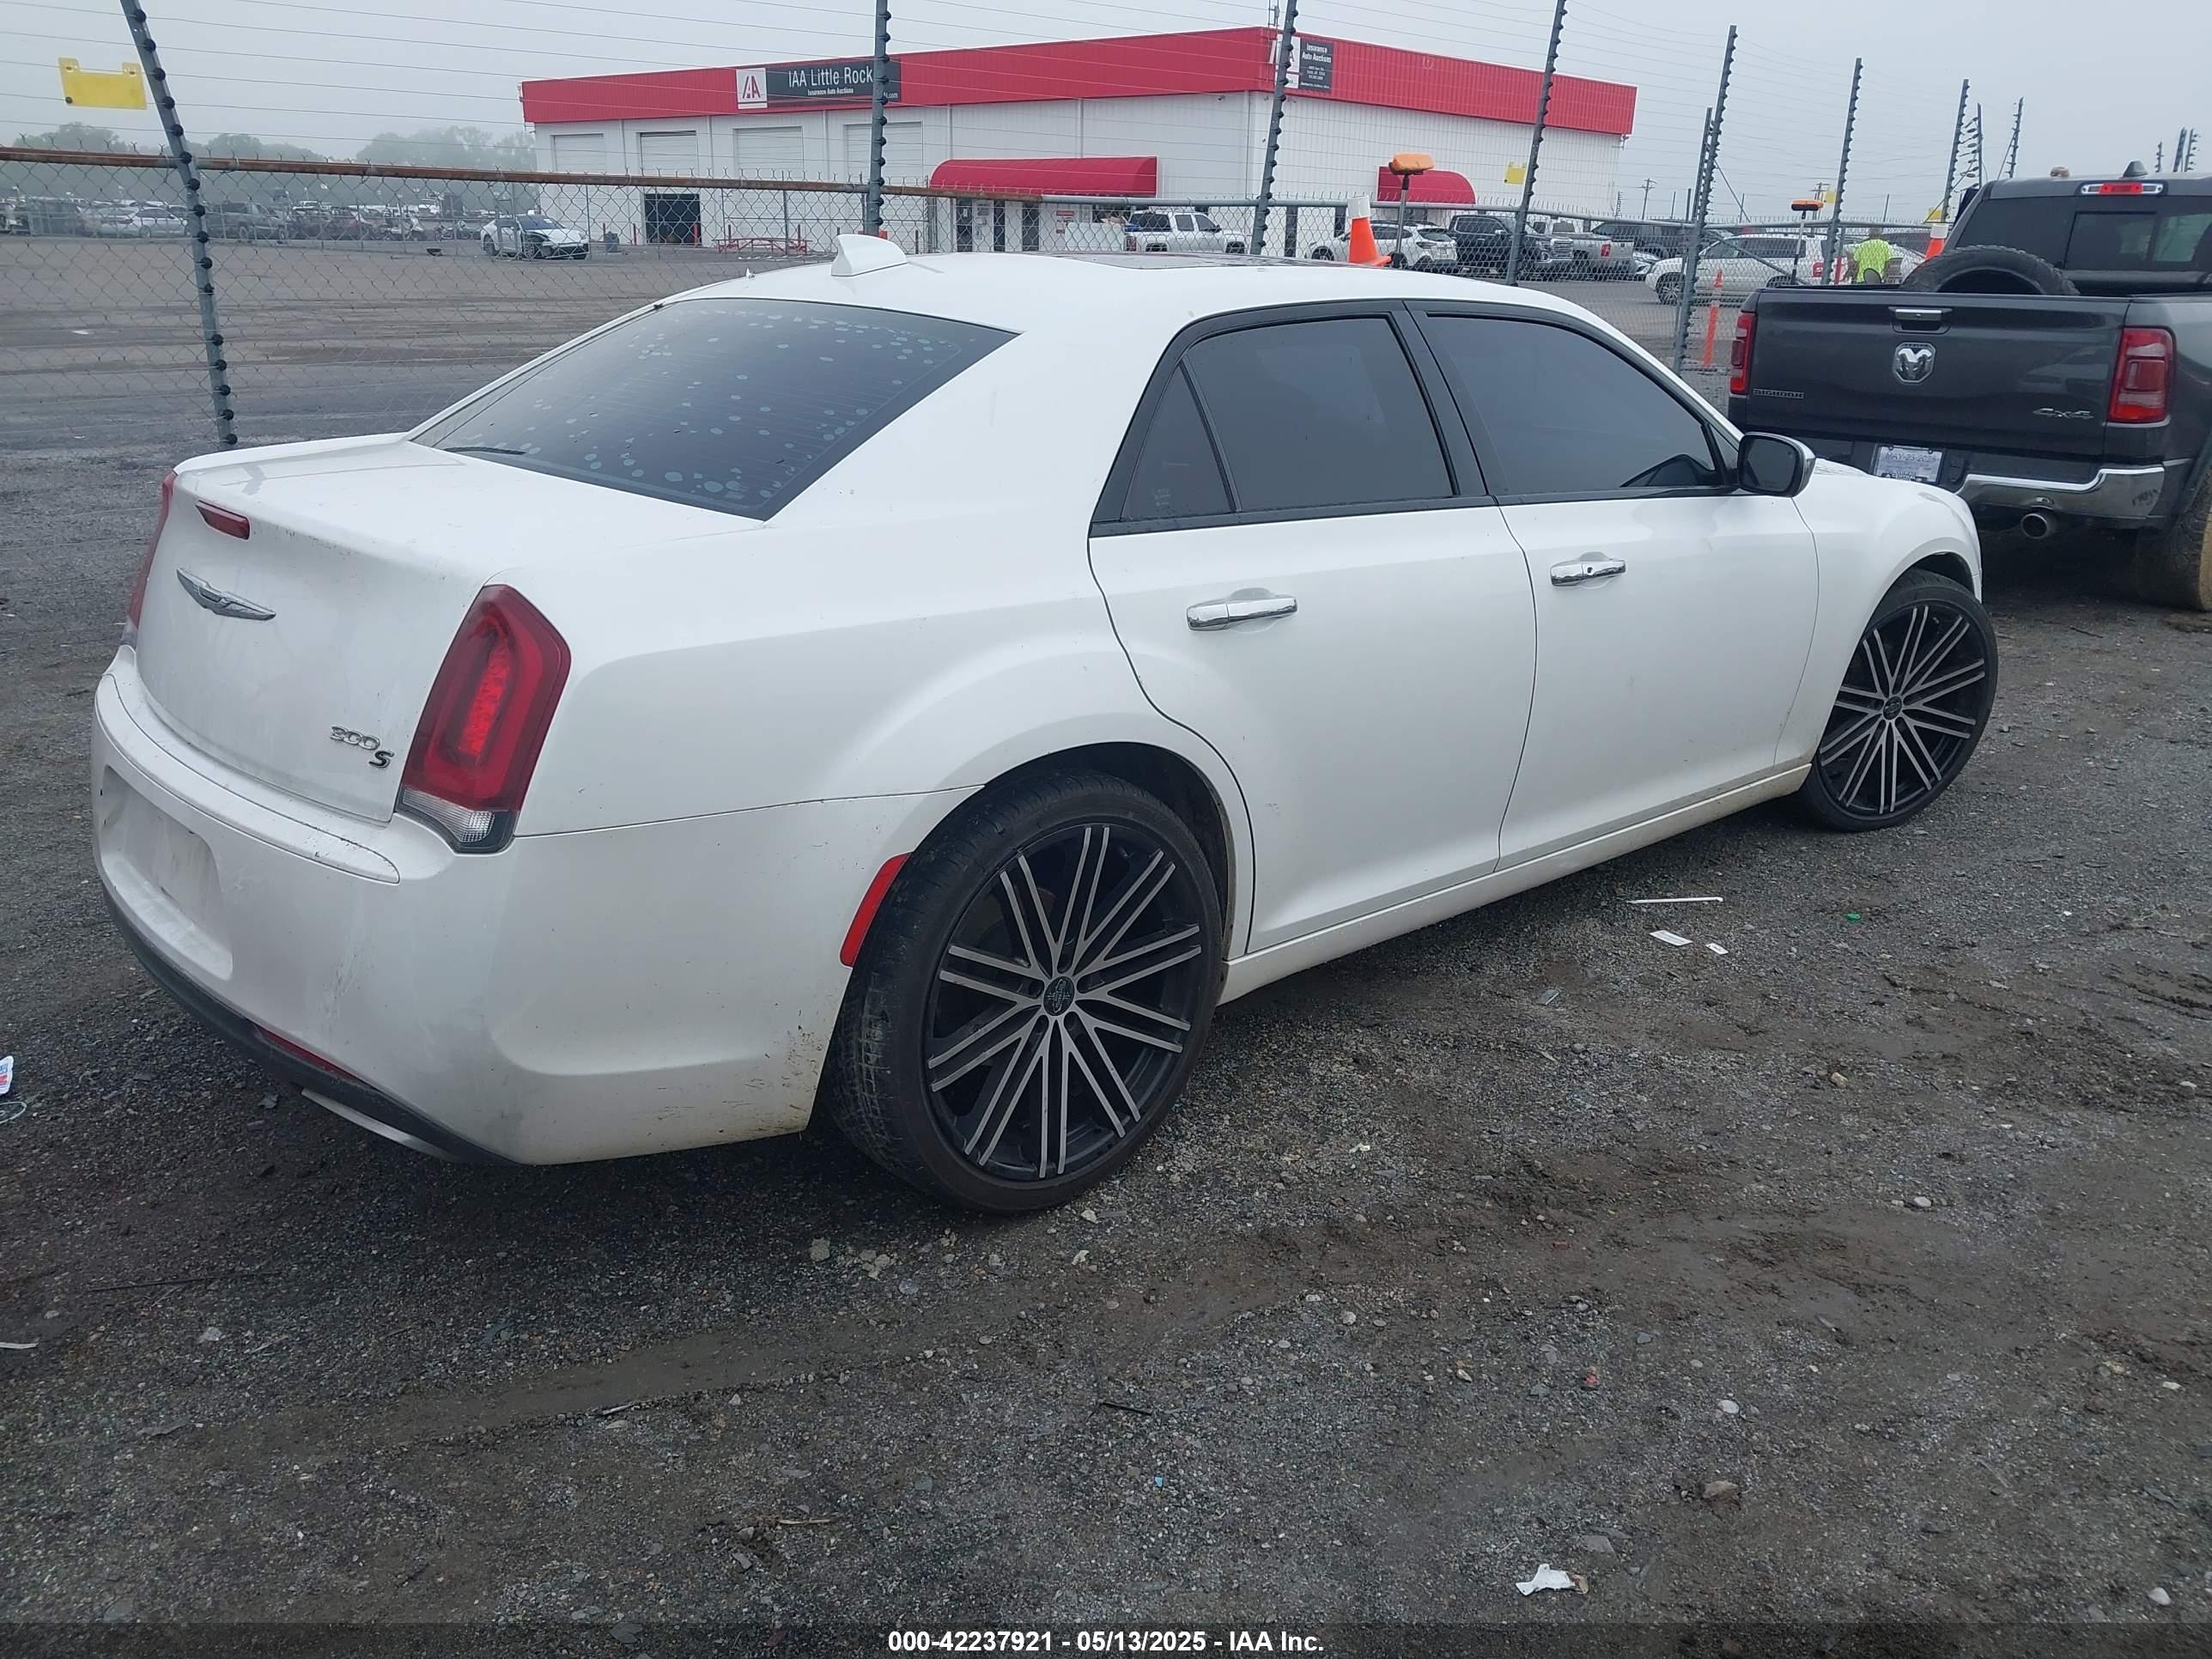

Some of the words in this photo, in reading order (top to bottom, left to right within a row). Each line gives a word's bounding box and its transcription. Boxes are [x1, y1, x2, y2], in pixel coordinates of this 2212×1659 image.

[788, 70, 807, 88] IAA
[811, 68, 840, 86] Little
[844, 65, 873, 85] Rock
[330, 726, 380, 750] 300
[368, 750, 395, 769] S
